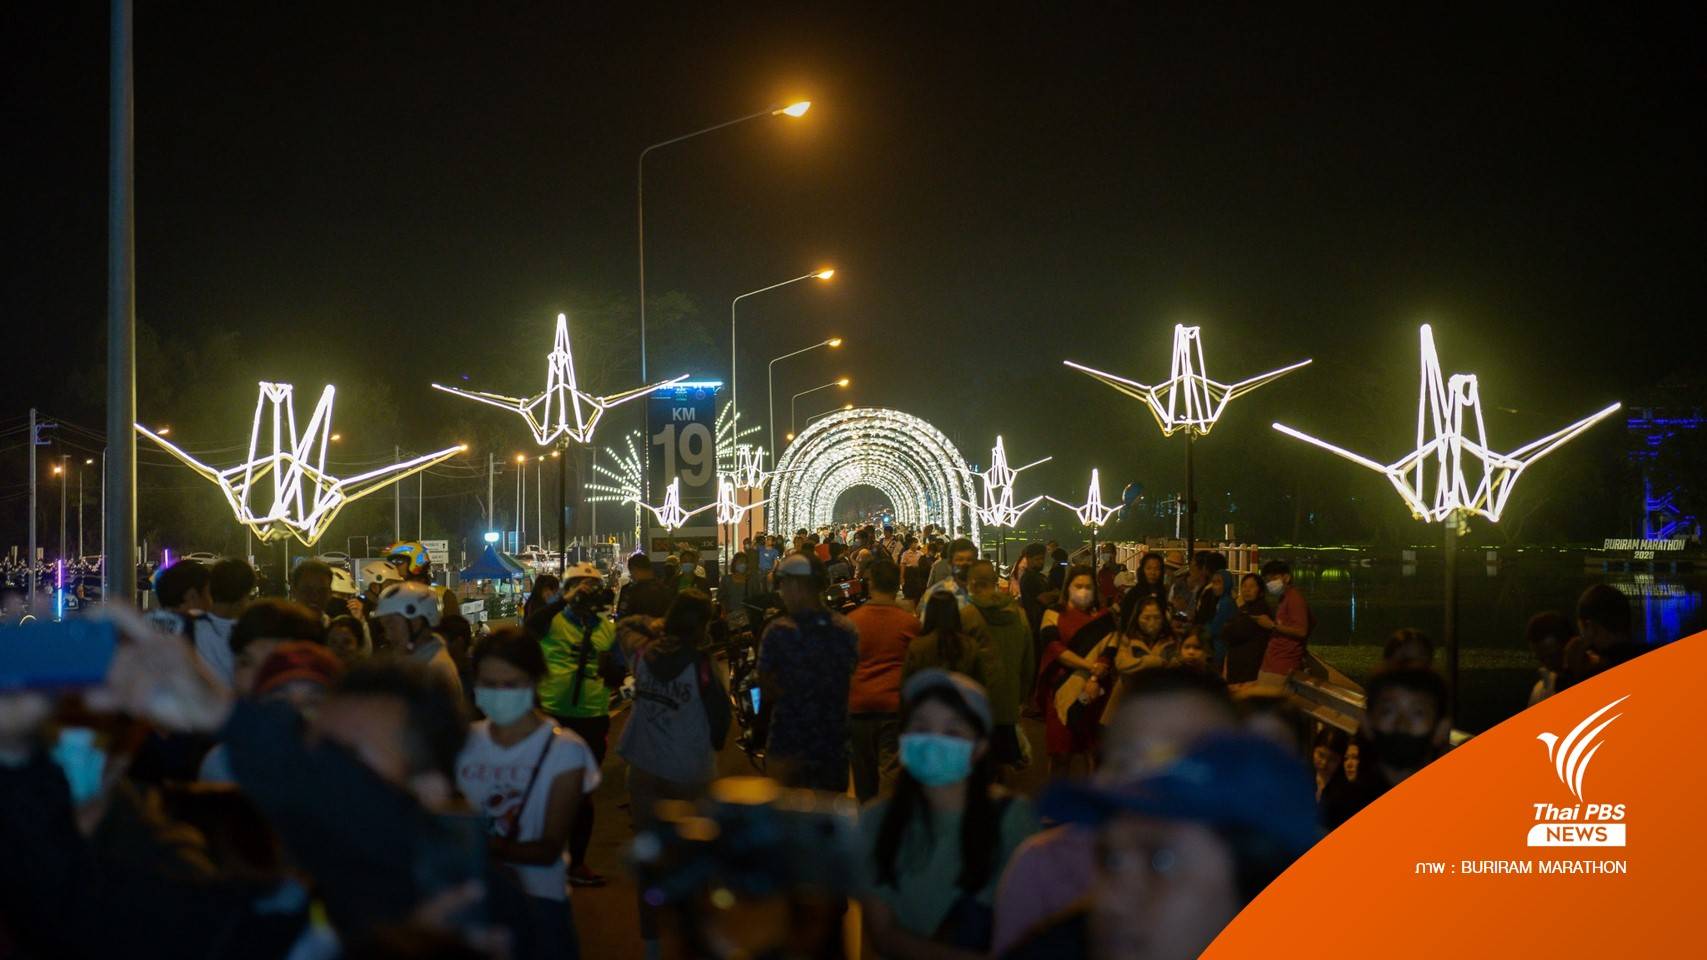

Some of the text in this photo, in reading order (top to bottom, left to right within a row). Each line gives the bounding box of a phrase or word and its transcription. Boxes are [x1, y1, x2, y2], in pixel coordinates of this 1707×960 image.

[672, 407, 696, 421] KM
[652, 422, 713, 488] 19
[1604, 538, 1685, 551] BURIRAM MARATHON
